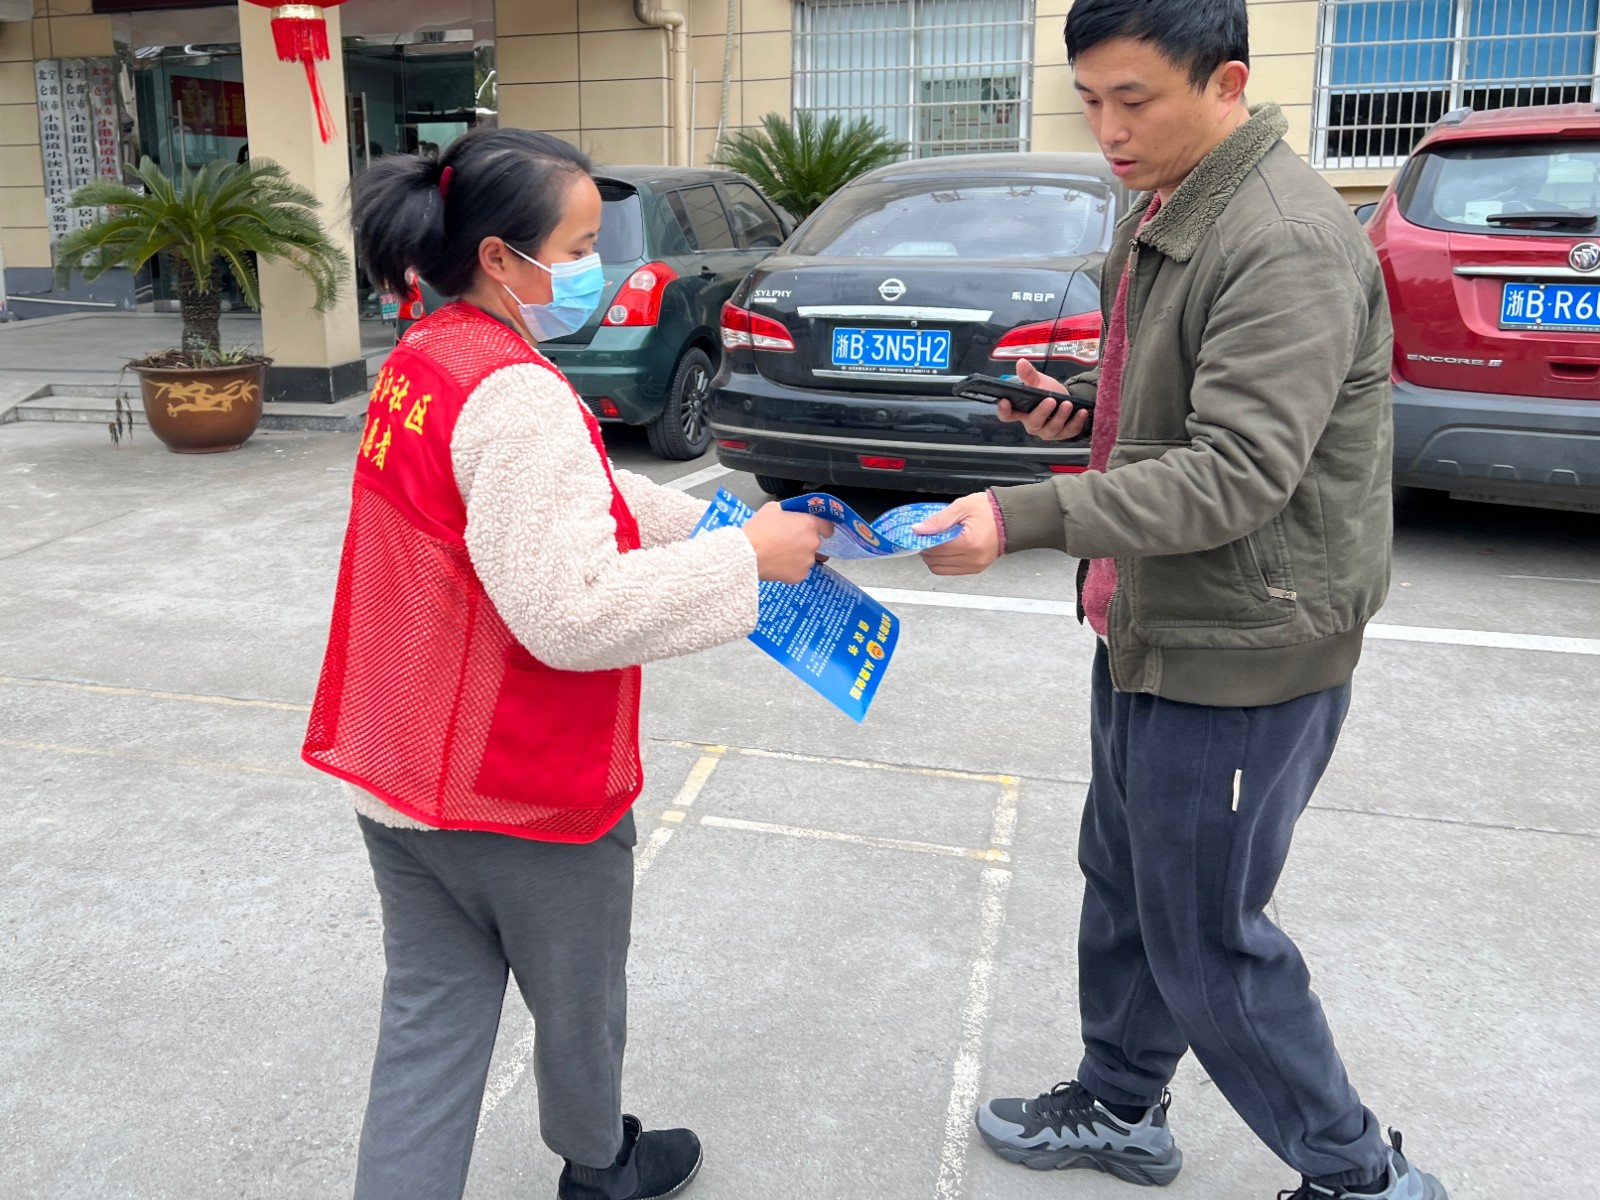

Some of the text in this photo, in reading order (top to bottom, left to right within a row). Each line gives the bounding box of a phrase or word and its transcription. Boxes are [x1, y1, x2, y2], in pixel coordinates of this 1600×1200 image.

[754, 289, 792, 298] SYLPHY
[1505, 289, 1600, 320] 浙B·R6
[1406, 353, 1485, 367] ENCORE
